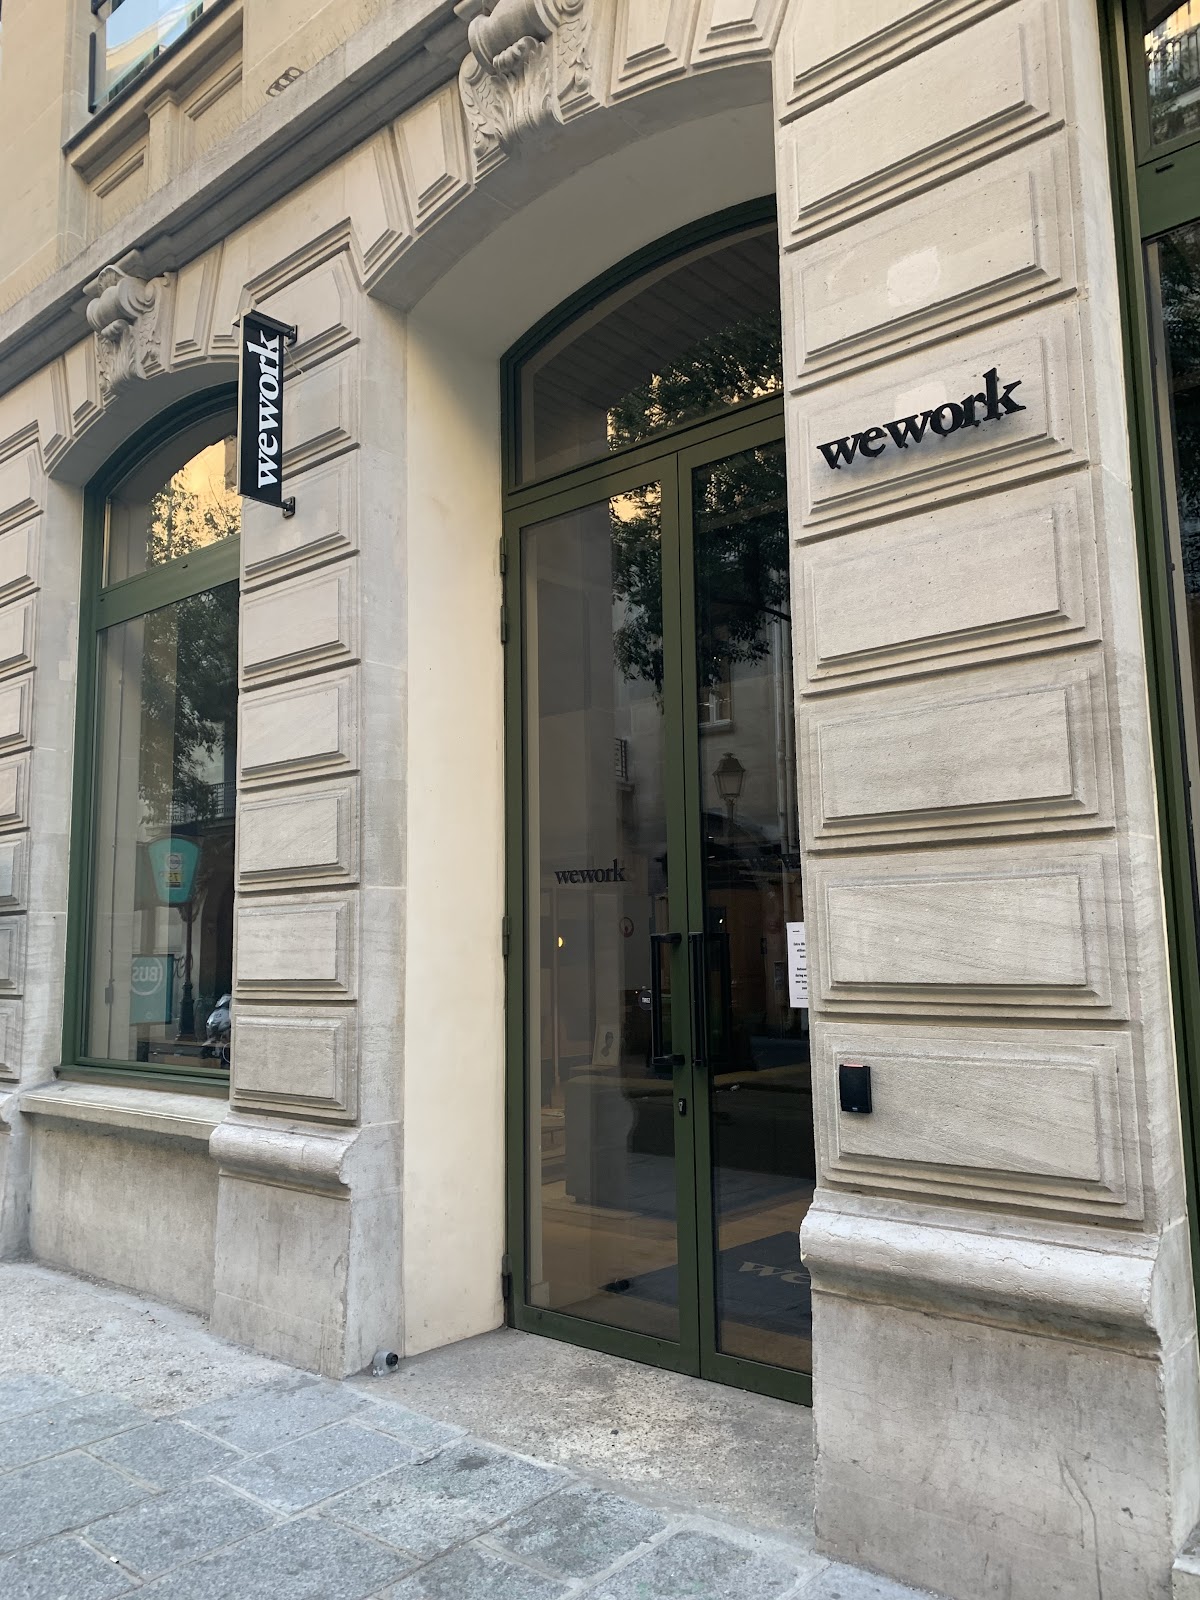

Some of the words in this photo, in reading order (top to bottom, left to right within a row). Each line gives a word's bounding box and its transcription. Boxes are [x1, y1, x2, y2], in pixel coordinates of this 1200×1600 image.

[247, 330, 280, 489] wework
[817, 367, 1027, 470] wework
[554, 858, 627, 885] wework
